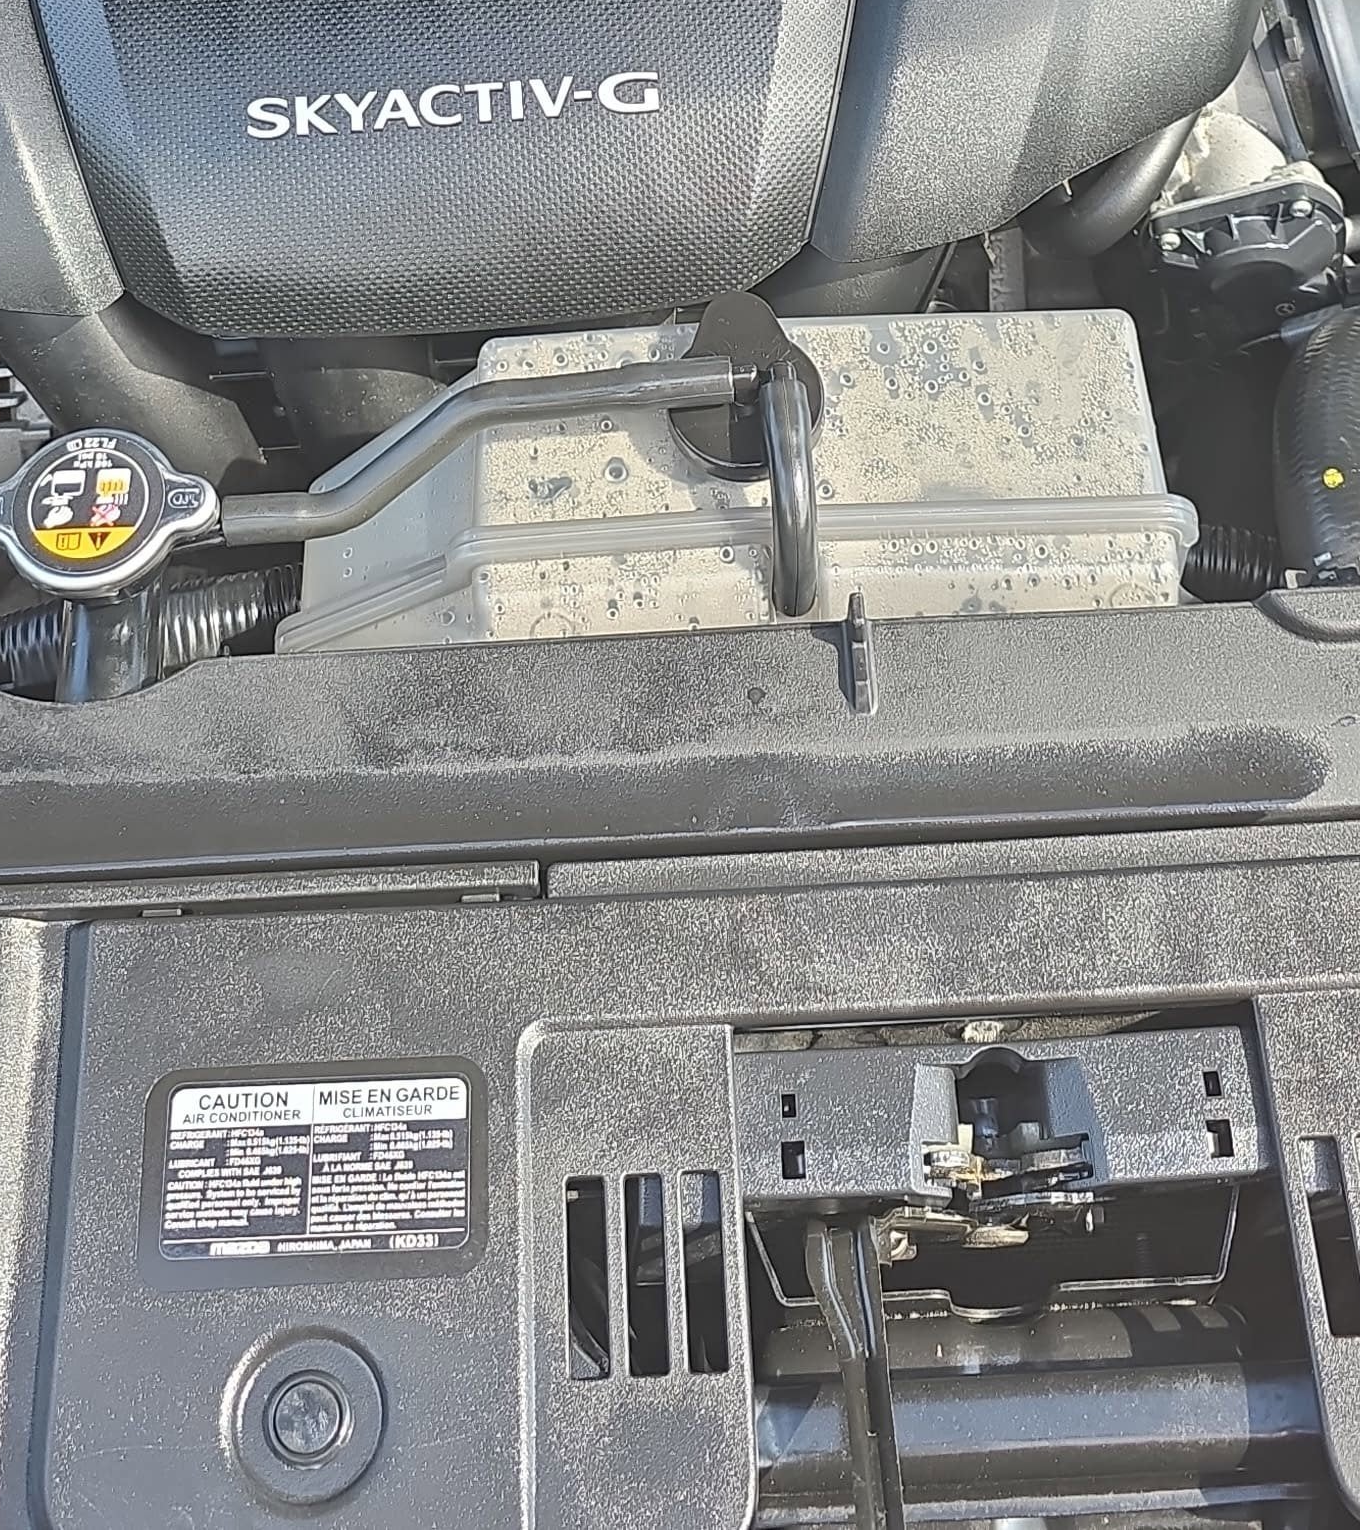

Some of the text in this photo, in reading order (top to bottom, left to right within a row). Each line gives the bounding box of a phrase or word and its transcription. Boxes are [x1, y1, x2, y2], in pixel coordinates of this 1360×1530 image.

[245, 70, 660, 139] SKYACTIV-G
[84, 437, 117, 449] FL22
[199, 1091, 288, 1110] CAUTION
[320, 1086, 460, 1105] MISE EN GARDE
[183, 1110, 301, 1124] AIR CONDITIONER
[343, 1104, 432, 1118] CLIMATISEUR
[167, 1181, 204, 1190] CAUTION
[338, 1238, 372, 1250] JAPAN
